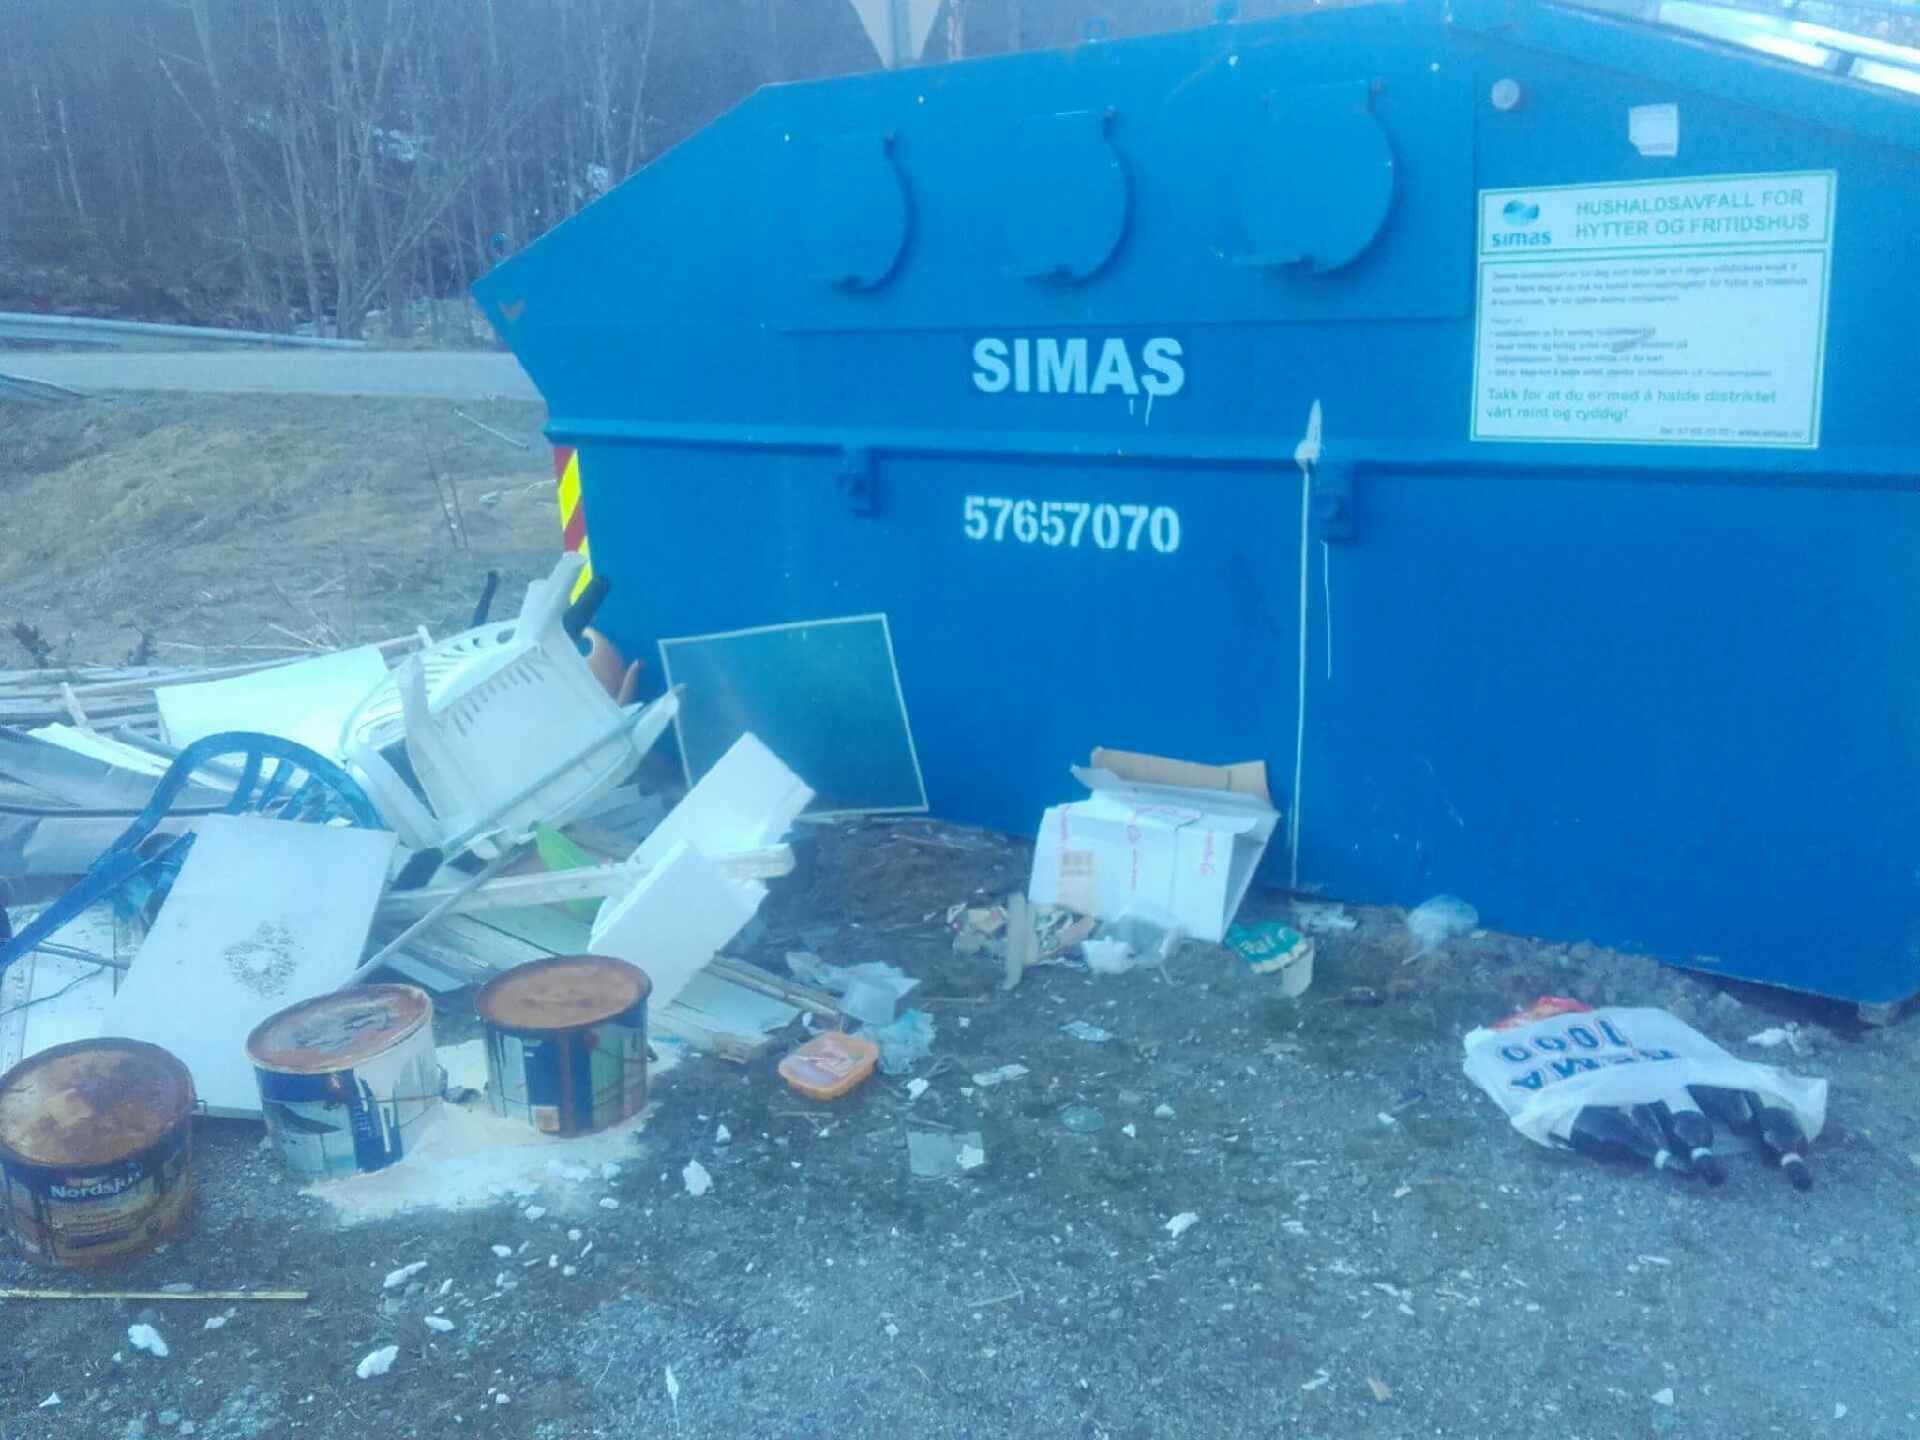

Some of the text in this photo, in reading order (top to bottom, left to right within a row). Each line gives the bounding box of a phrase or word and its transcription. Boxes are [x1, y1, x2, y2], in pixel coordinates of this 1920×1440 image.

[1577, 188, 1805, 217] HUSHALDSAVFALL FOR
[1491, 230, 1552, 248] simas
[1575, 213, 1810, 239] HYTTER OG FRITIDSHUS
[972, 337, 1185, 396] SIMAS
[1488, 388, 1518, 402] Takk
[1523, 388, 1541, 402] for
[1547, 389, 1562, 402] at
[1565, 389, 1583, 402] du
[1587, 391, 1604, 402] er
[1607, 390, 1640, 402] med
[1704, 391, 1776, 405] distriktet
[1552, 409, 1570, 423] og
[963, 495, 1182, 555] 57657070
[1500, 1019, 1631, 1063] 1000
[1509, 1046, 1681, 1091] MA
